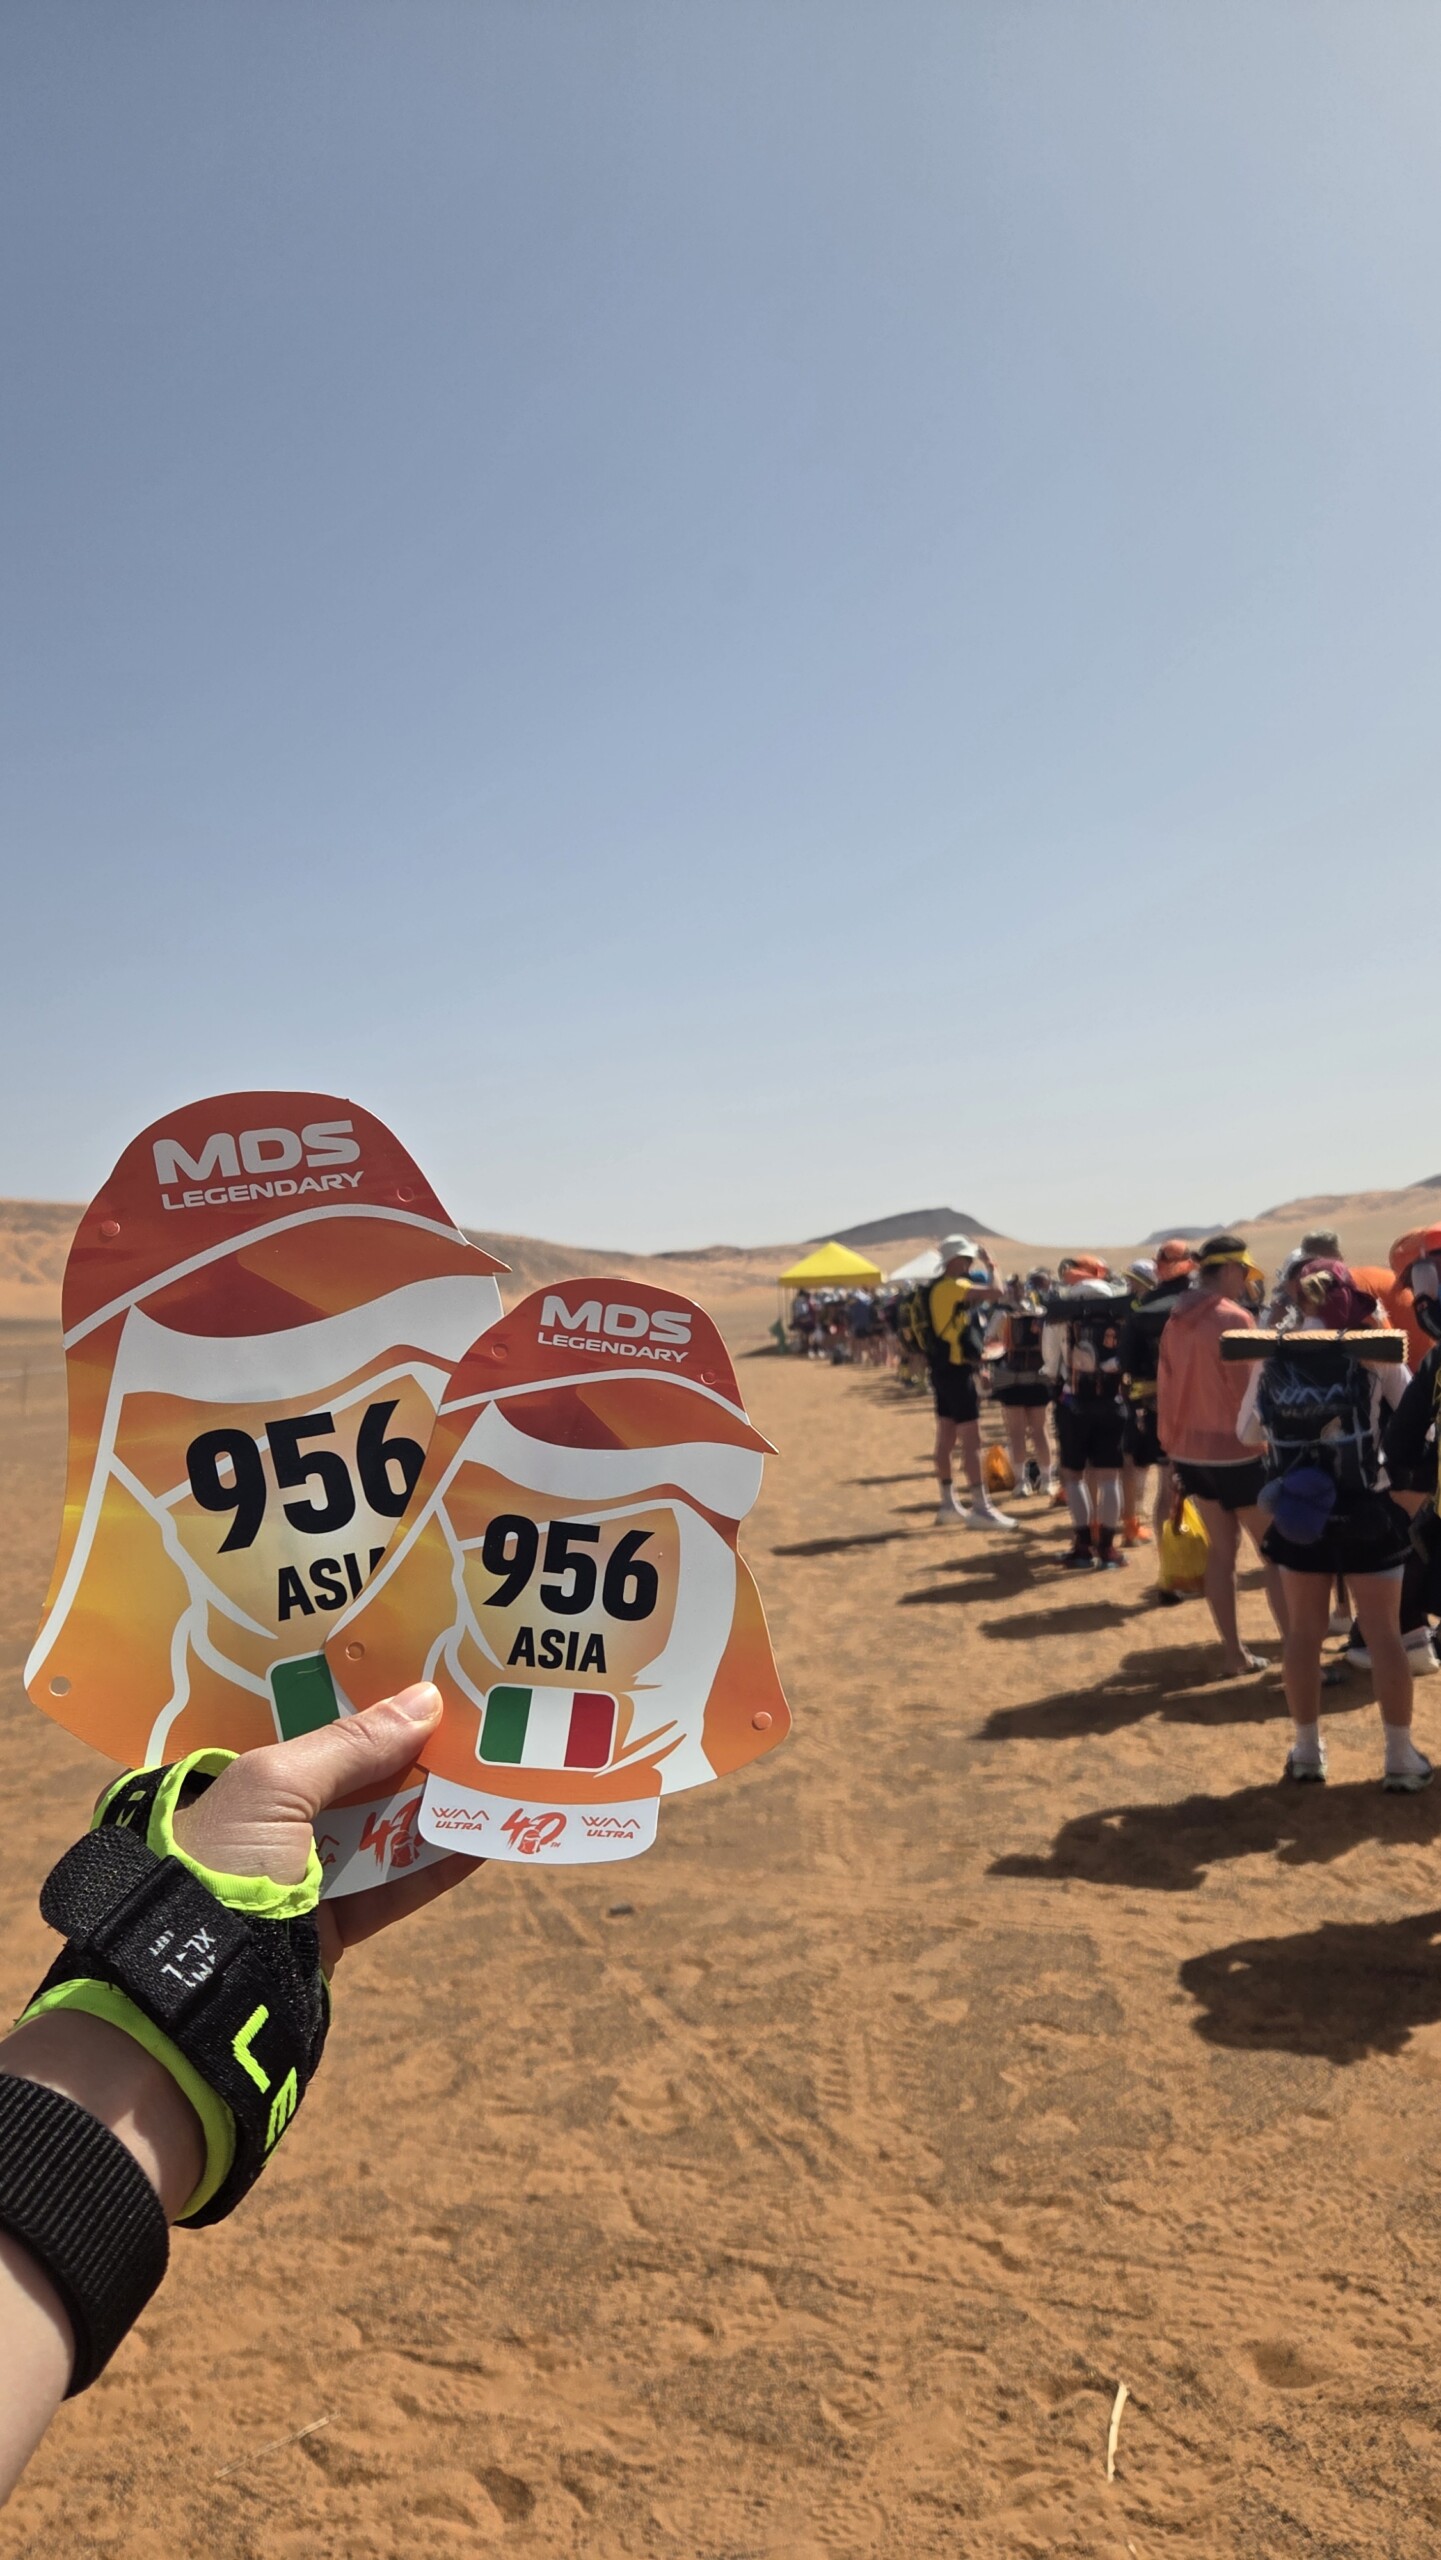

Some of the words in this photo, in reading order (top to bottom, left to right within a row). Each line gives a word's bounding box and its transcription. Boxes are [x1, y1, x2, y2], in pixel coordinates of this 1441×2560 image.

[152, 1120, 361, 1184] MDS
[161, 1171, 364, 1210] LEGENDARY
[540, 1295, 692, 1345] MDS
[538, 1332, 688, 1363] LEGENDARY
[186, 1399, 426, 1554] 956
[482, 1514, 659, 1621] 956
[506, 1627, 607, 1673] ASIA
[435, 1820, 482, 1831] ULTRA
[586, 1829, 634, 1839] ULTRA
[148, 1930, 175, 1956] LEFT
